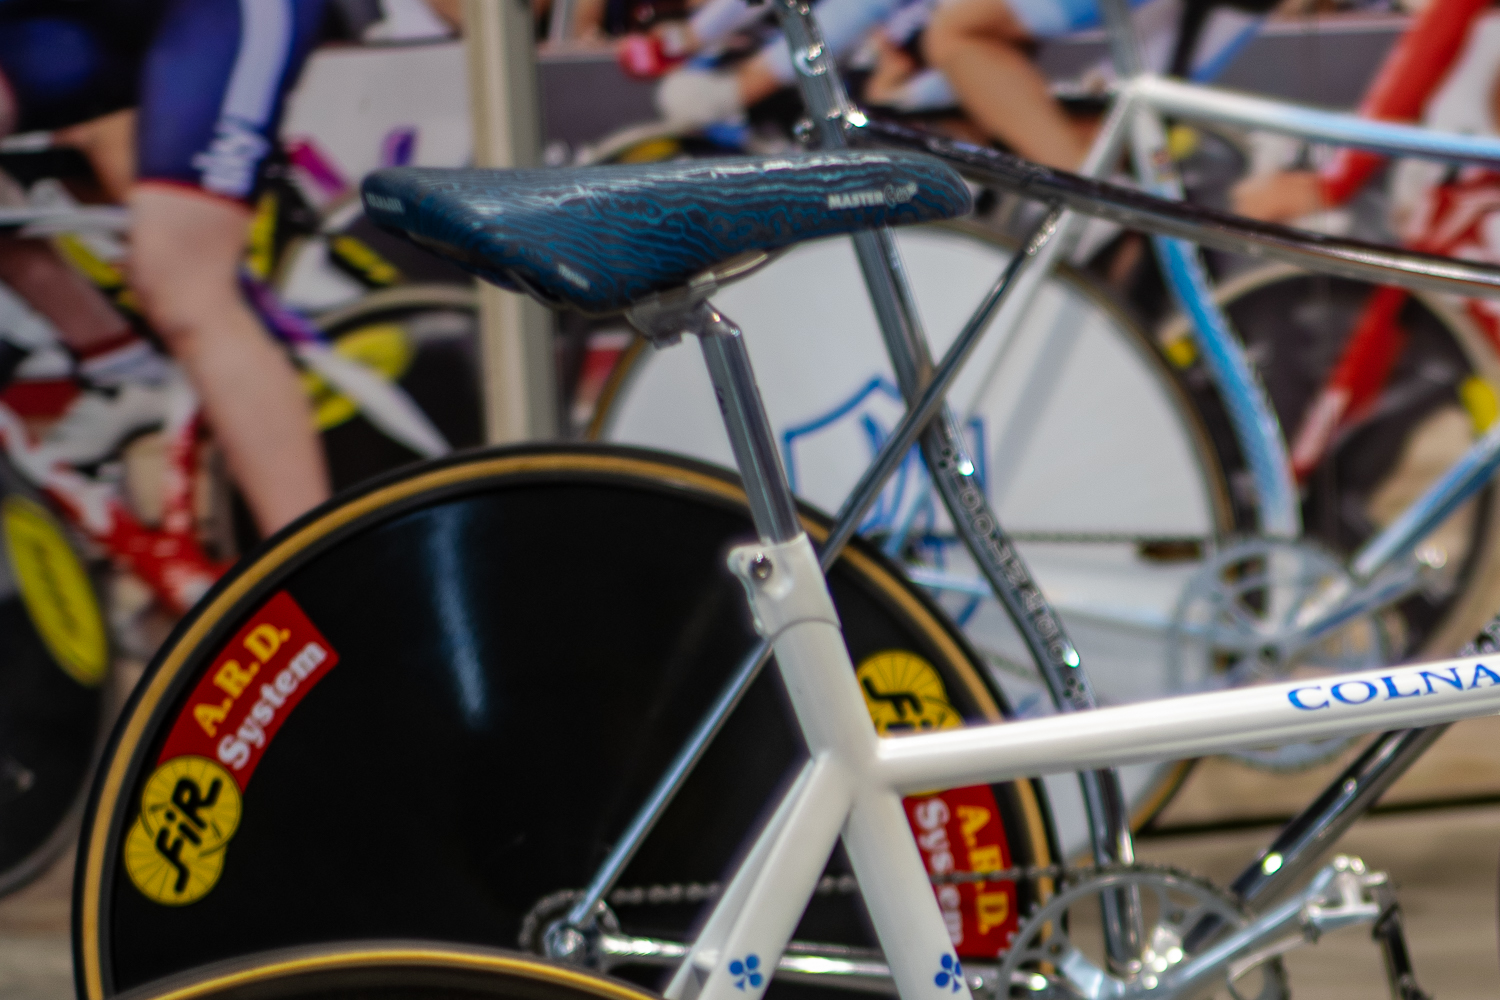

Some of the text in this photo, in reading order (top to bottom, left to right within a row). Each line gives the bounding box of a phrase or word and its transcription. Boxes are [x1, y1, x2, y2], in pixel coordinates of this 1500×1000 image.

[827, 190, 884, 211] MASTER
[193, 622, 292, 739] A.R.D.
[216, 640, 328, 771] System
[913, 797, 965, 948] Sysem
